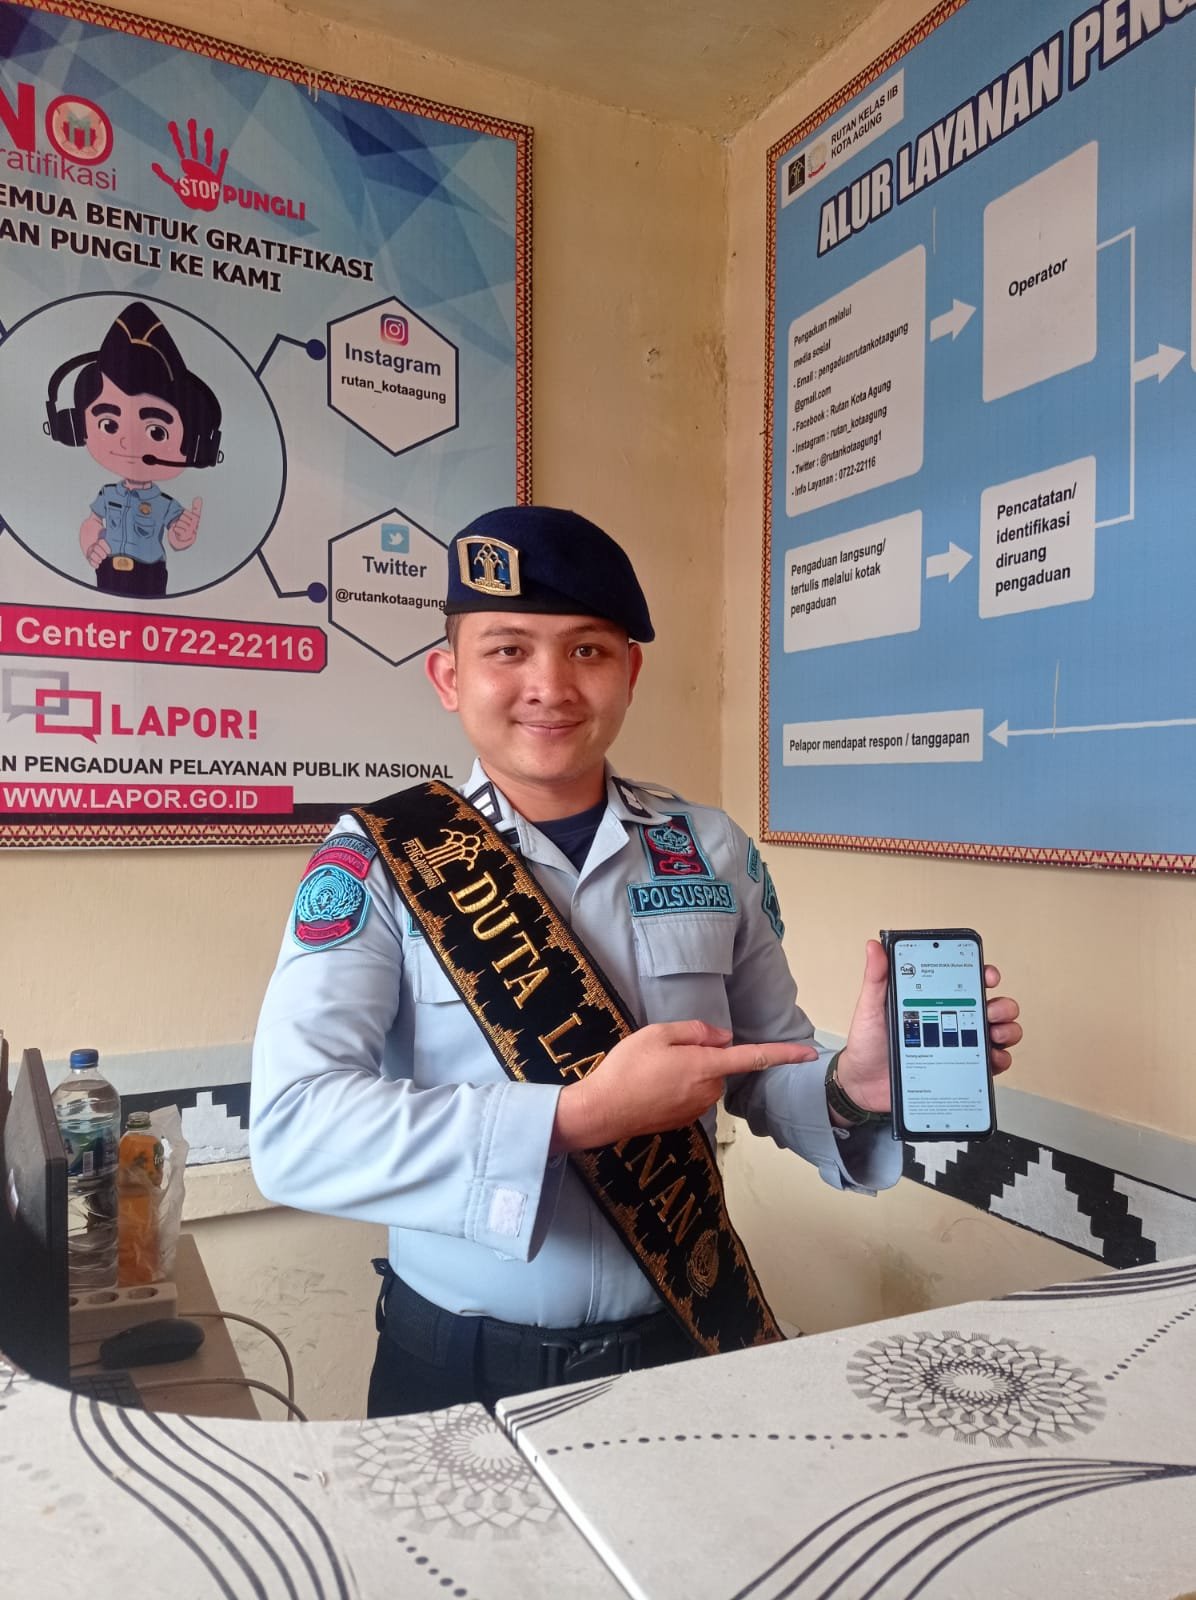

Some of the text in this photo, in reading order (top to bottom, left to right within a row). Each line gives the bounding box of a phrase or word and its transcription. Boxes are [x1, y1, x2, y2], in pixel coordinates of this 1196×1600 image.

[831, 85, 898, 145] RUTAN KELAS IIB
[818, 161, 891, 256] ALUR
[900, 34, 1061, 203] LAYANAN
[831, 112, 882, 159] KOTA AGUNG
[180, 176, 305, 220] STOP PUNGLI
[51, 227, 162, 268] PUNGLI
[170, 251, 203, 277] KE
[213, 260, 282, 292] KAMI
[87, 204, 199, 245] BENTUK
[206, 228, 374, 282] GRATIFIKASI
[1008, 257, 1068, 297] Operator
[793, 304, 852, 347] Pengaduan melalui
[345, 342, 441, 377] Instagram
[794, 338, 831, 368] media sosial
[797, 370, 813, 388] Email
[818, 322, 909, 380] pengaduanrutankotaagung
[341, 374, 447, 404] rutan_kotaagung
[794, 386, 832, 413] @gmail.com
[796, 410, 825, 432] Facebook
[830, 400, 849, 415] Rutan
[850, 391, 867, 405] Kota
[868, 379, 892, 399] Agung
[795, 434, 826, 454] Instagram
[830, 406, 887, 434] rutan_kotaagung
[795, 459, 815, 475] Twitter
[820, 429, 882, 467] @rutankotaagung1
[795, 483, 806, 497] Info
[807, 474, 833, 492] Layanan
[838, 456, 876, 480] 0722-22116
[997, 482, 1077, 520] Pencatatan/
[996, 512, 1070, 545] identifikasi
[362, 555, 427, 579] Twitter
[791, 537, 886, 577] Pengaduan langsung/
[996, 544, 1047, 570] diruang
[790, 562, 881, 596] tertulis melalui kotak
[995, 565, 1071, 597] pengaduan
[335, 588, 446, 611] @rutankotaagung
[790, 595, 837, 618] pengaduan
[16, 616, 132, 650] Center
[142, 625, 314, 662] 0722-22116
[111, 704, 258, 740] LAPOR!
[790, 737, 820, 753] Pelapor
[822, 734, 867, 753] mendapat
[868, 734, 903, 751] respon
[911, 731, 970, 749] tanggapan
[25, 756, 163, 775] PENGADUAN
[170, 759, 287, 777] PELAYANAN
[292, 761, 360, 778] PUBLIK
[364, 762, 453, 780] NASIONAL
[3, 787, 258, 810] WWW.LAPOR.GO.ID
[638, 886, 730, 910] POLSUSPAS
[448, 871, 549, 1009] DUTA
